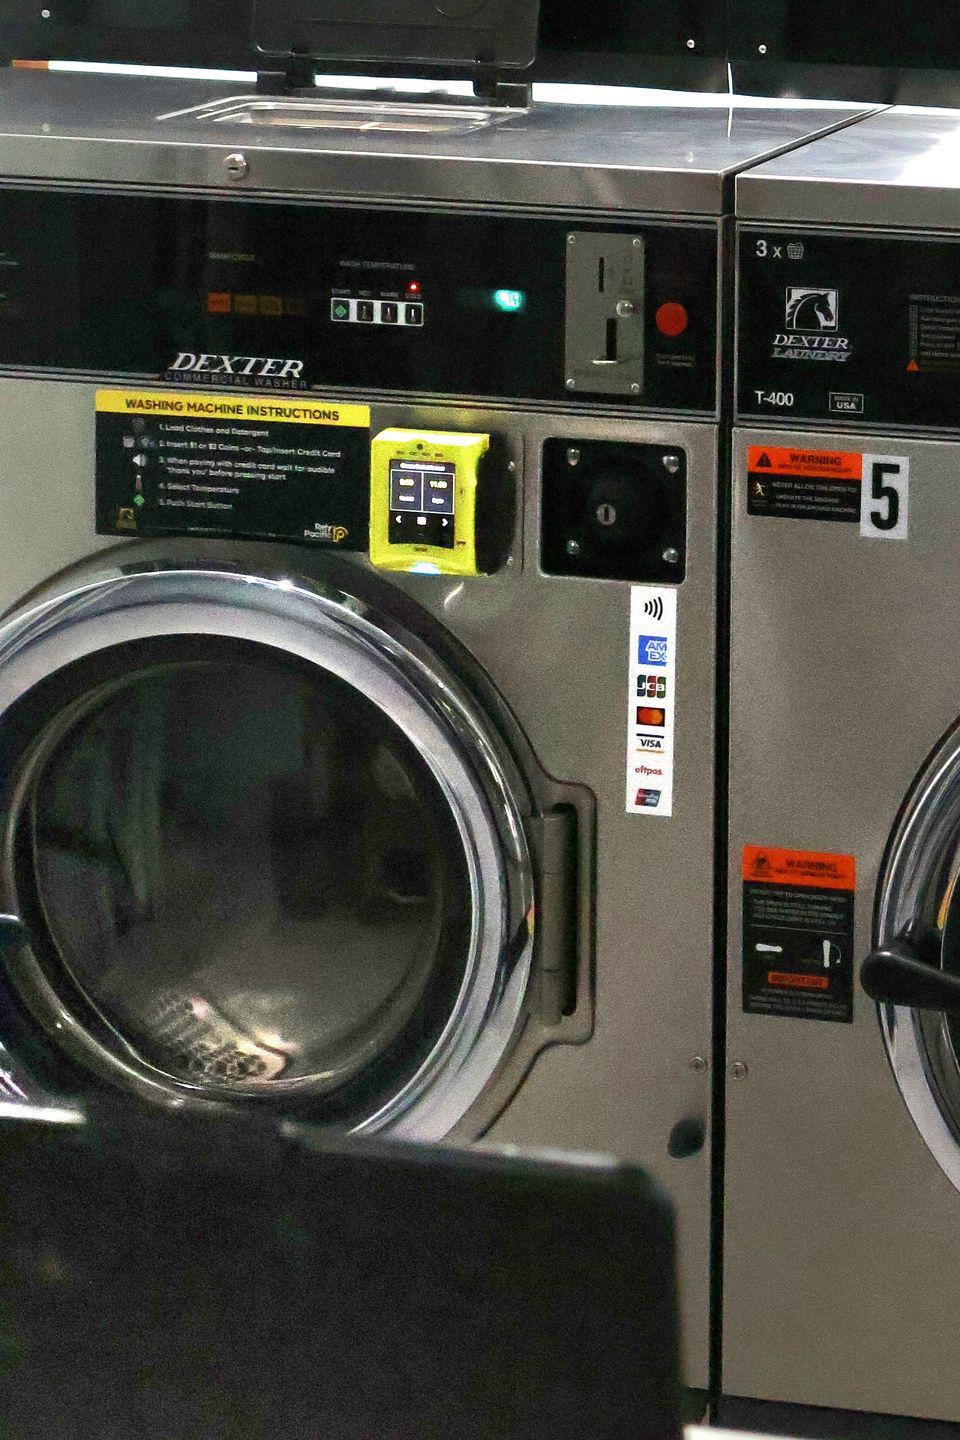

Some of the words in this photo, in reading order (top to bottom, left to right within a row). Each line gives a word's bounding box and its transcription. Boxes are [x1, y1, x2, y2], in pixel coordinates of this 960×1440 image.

[756, 240, 768, 257] 3
[772, 334, 848, 349] DEXTER
[168, 353, 303, 378] DEXTER
[754, 391, 794, 406] T-400
[837, 402, 856, 410] USA
[126, 399, 183, 411] WASHING
[187, 403, 243, 415] MACHINE
[247, 407, 339, 421] INSTRUCTIONS
[870, 463, 900, 530] 5
[640, 738, 662, 749] VISA
